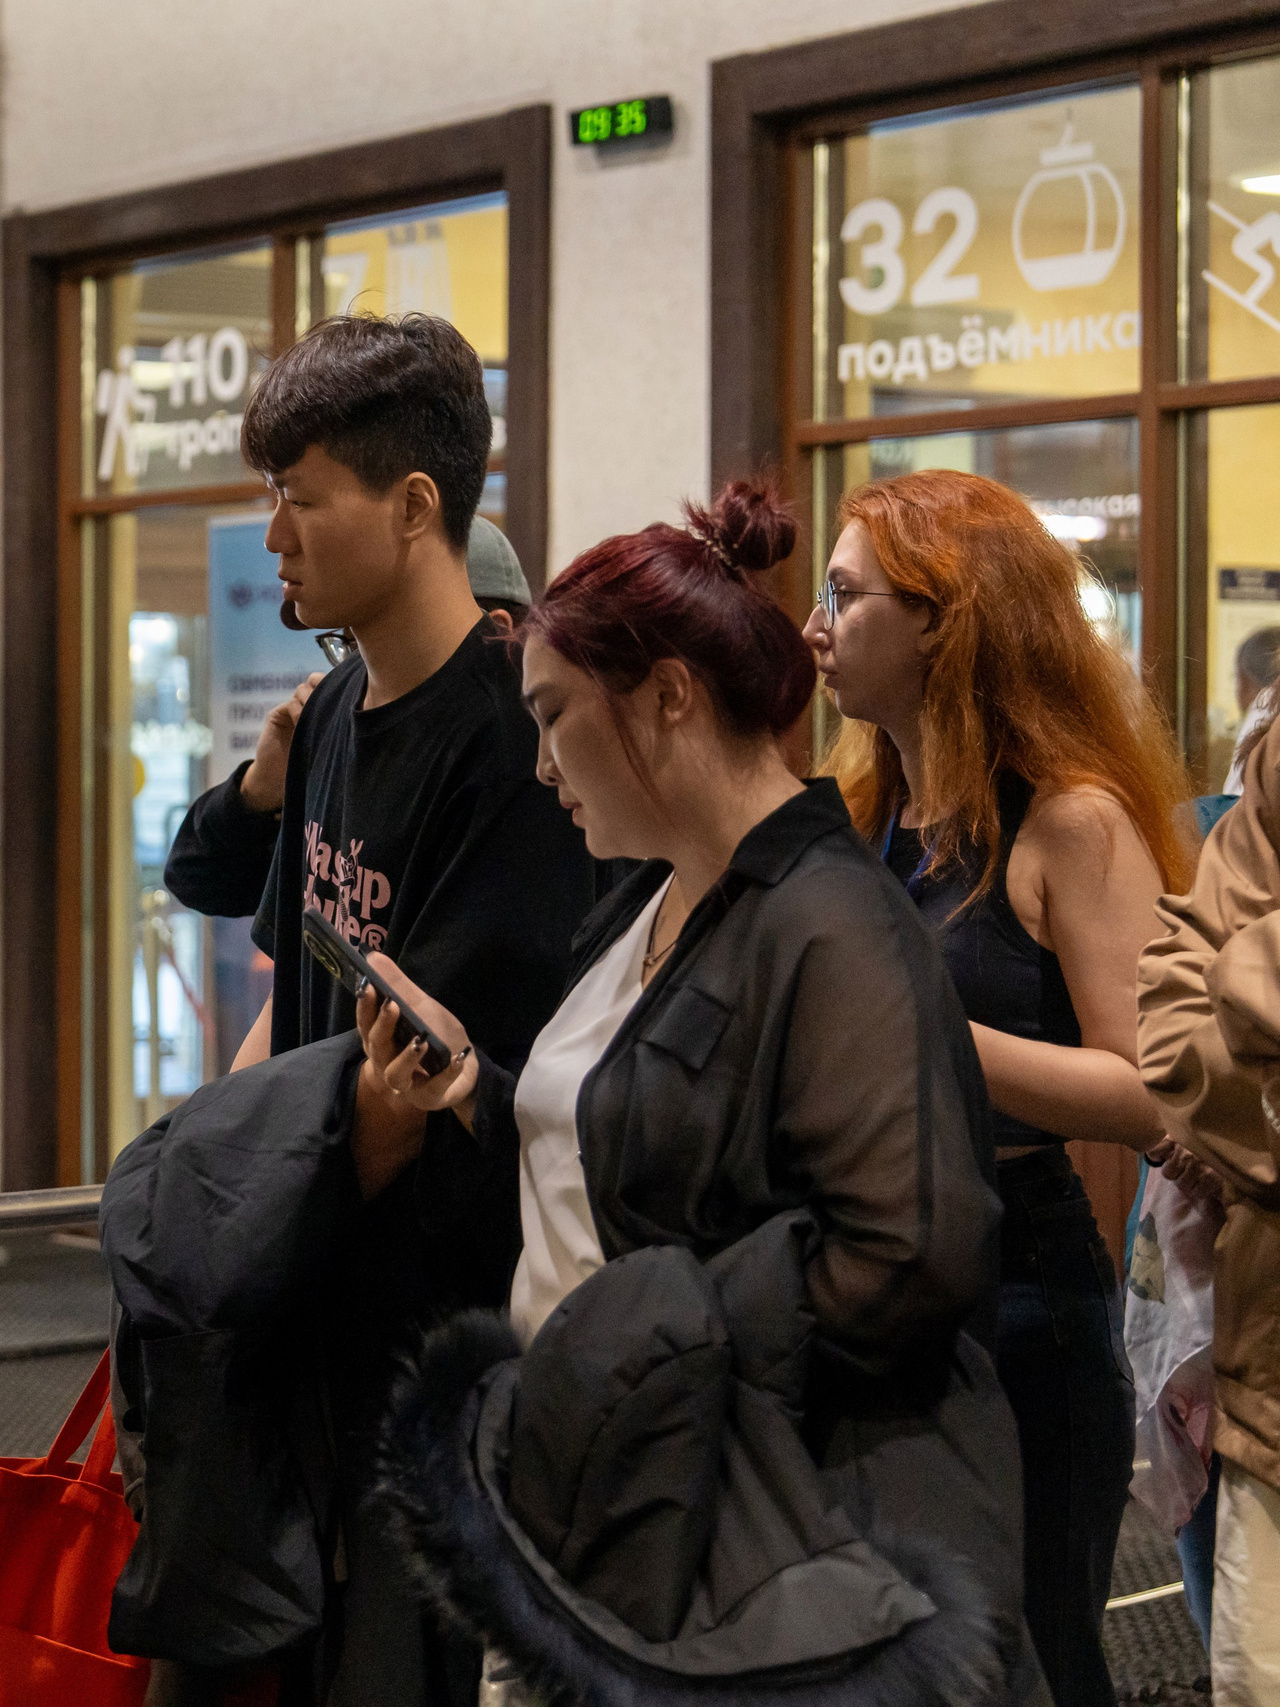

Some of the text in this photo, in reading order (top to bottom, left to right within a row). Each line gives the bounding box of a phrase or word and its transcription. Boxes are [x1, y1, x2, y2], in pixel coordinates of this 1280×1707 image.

[839, 187, 979, 315] 32
[162, 327, 248, 407] 110
[838, 312, 1141, 384] подъёмника
